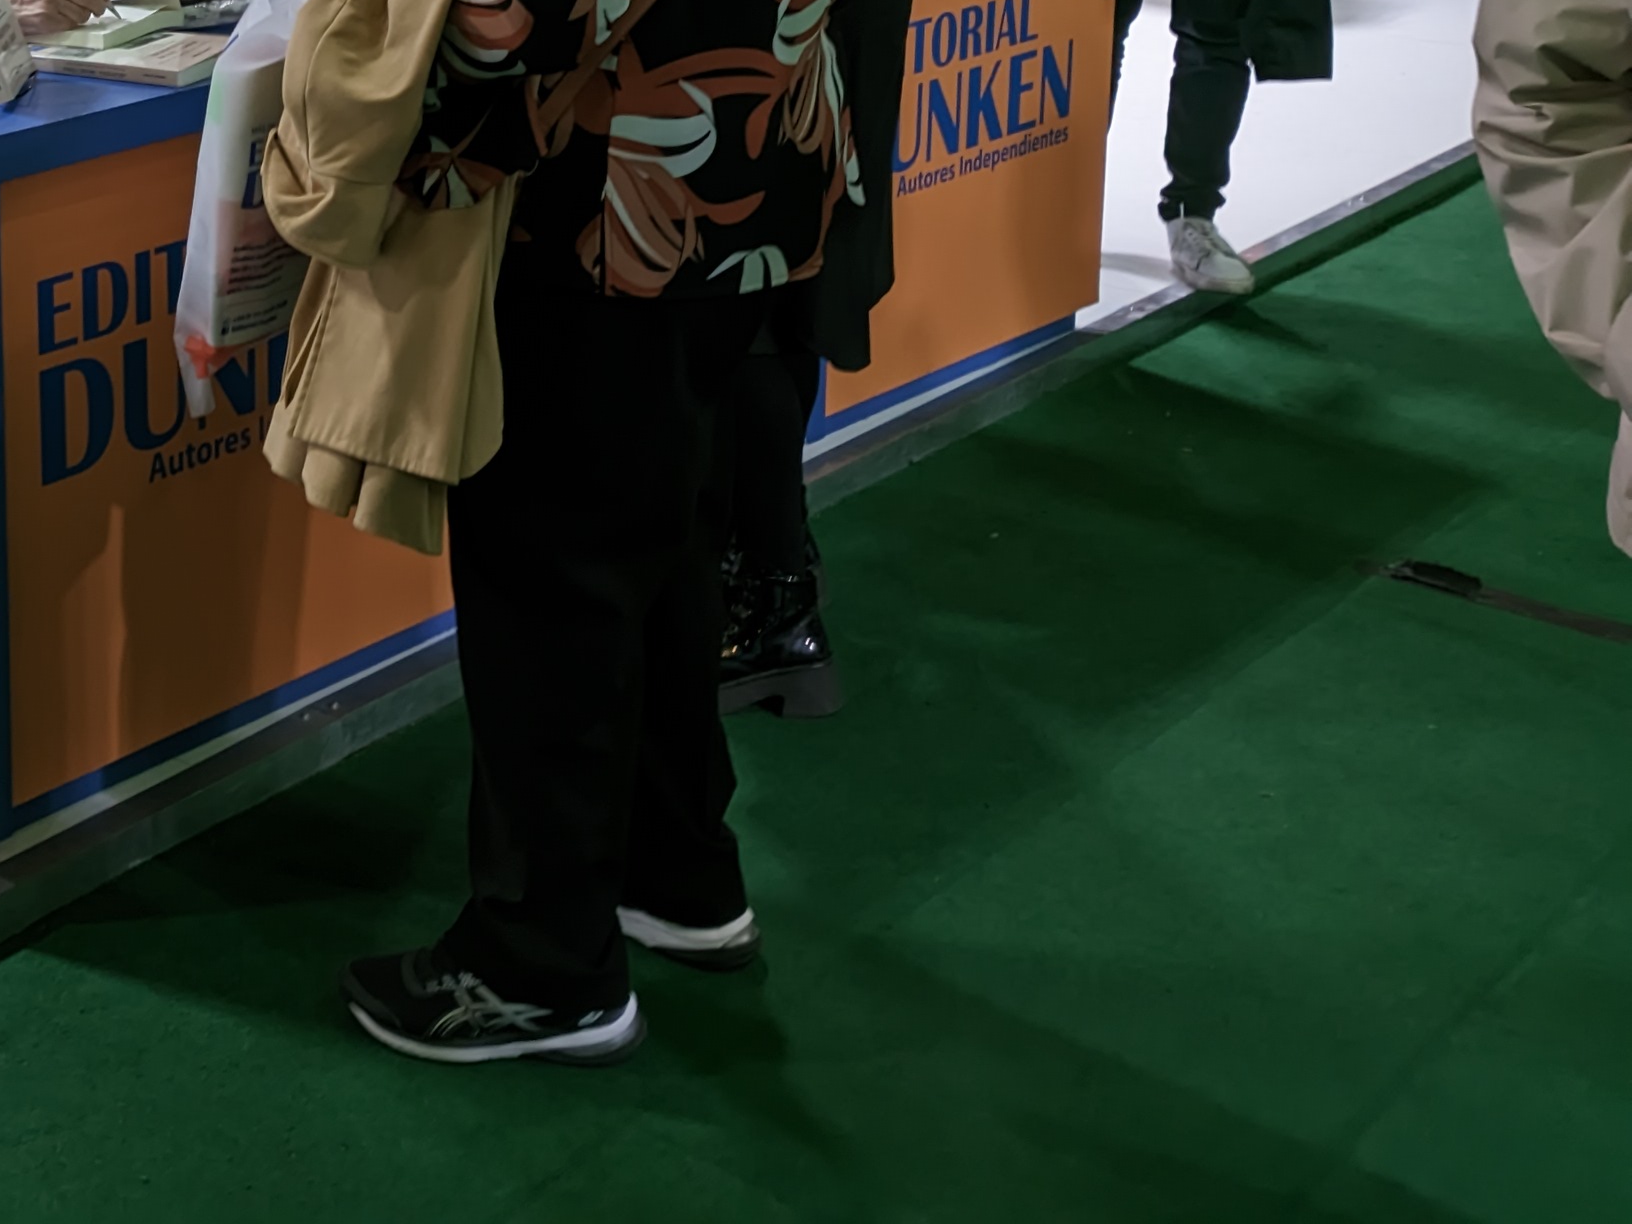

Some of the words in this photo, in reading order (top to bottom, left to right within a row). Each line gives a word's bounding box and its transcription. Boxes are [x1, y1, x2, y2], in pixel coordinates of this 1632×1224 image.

[896, 162, 956, 198] Autores
[958, 126, 1069, 176] Independientes
[38, 335, 287, 488] DUN
[148, 422, 251, 484] Autores
